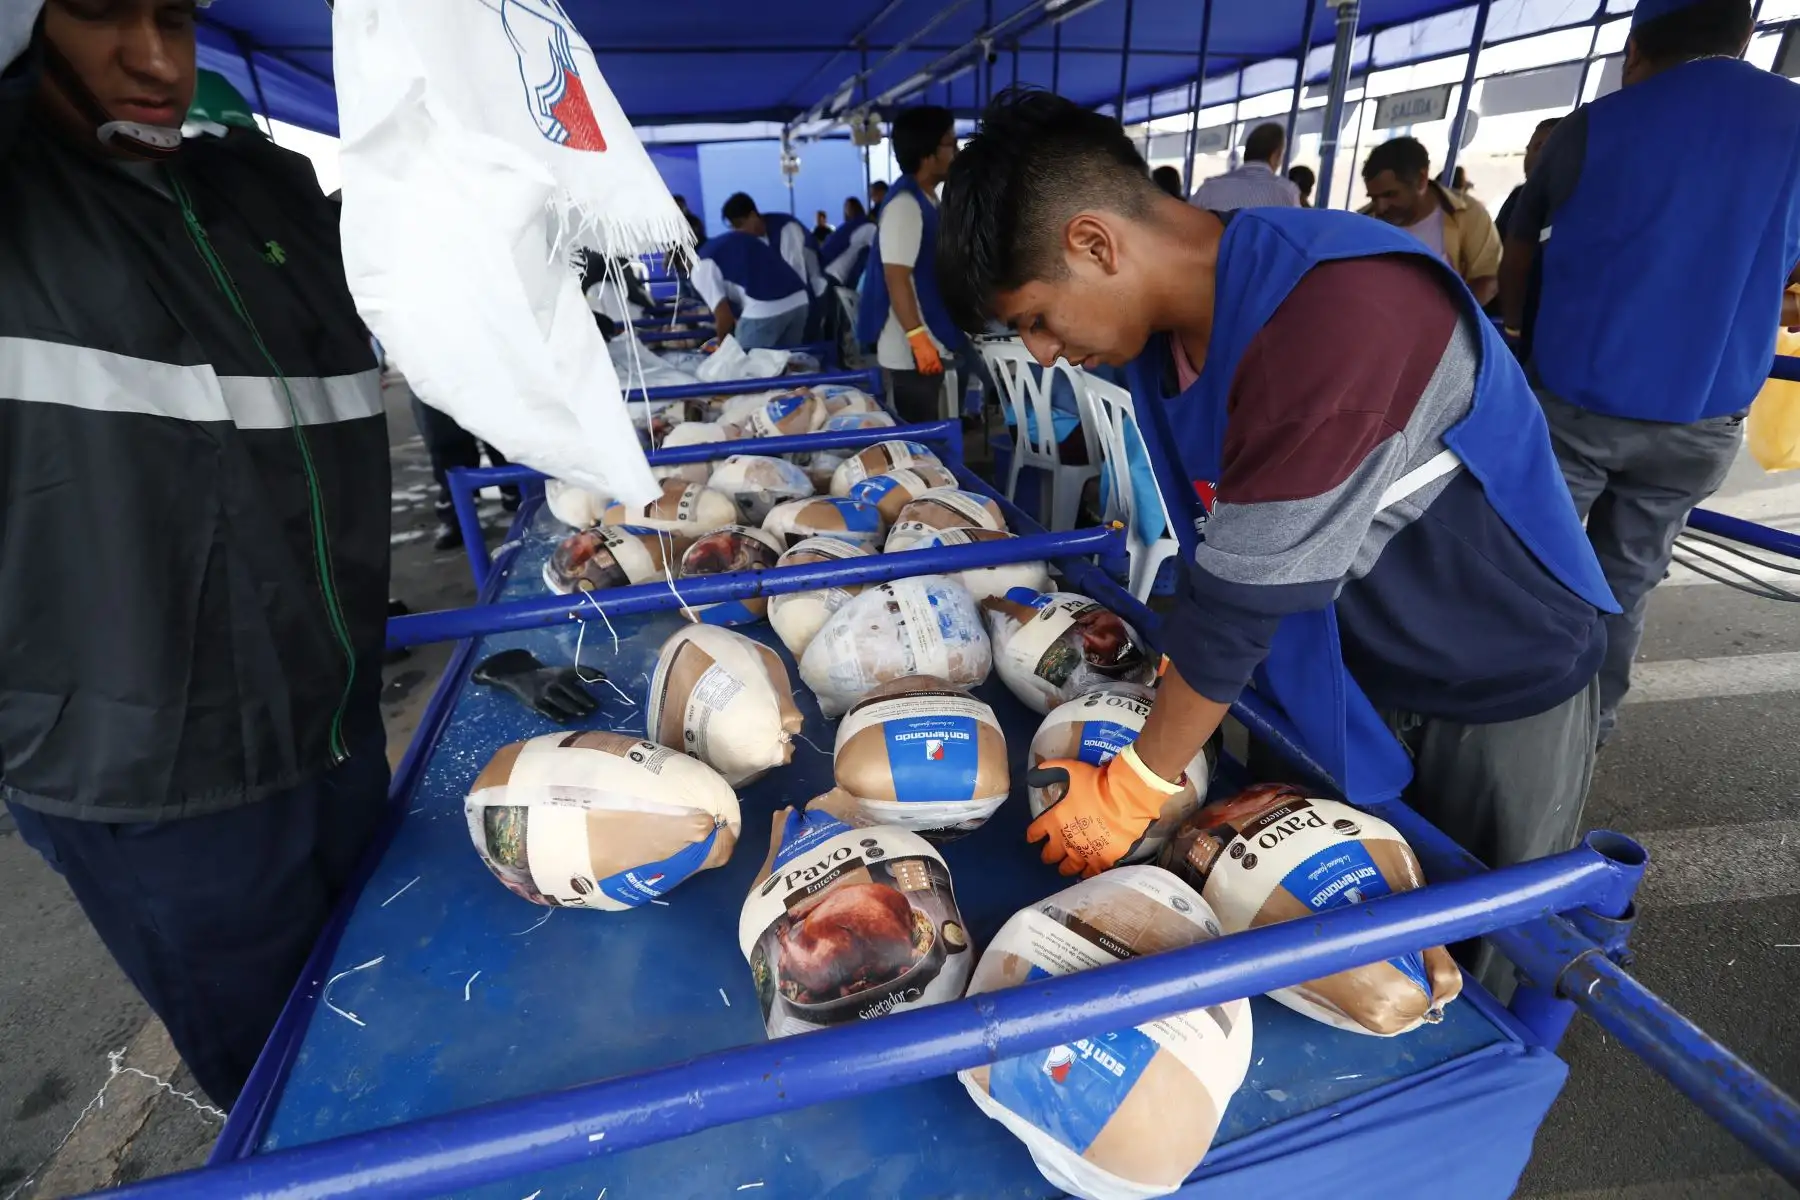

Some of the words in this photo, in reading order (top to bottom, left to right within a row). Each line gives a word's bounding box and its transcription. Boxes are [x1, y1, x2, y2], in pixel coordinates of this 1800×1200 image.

[1390, 99, 1431, 121] SALIDA
[1060, 600, 1084, 613] Pa
[1106, 698, 1149, 718] avo
[1259, 806, 1292, 826] Entero
[1258, 810, 1328, 849] Pavo
[784, 846, 852, 892] Pavo
[806, 869, 840, 894] Entero
[858, 990, 906, 1020] Sujetador
